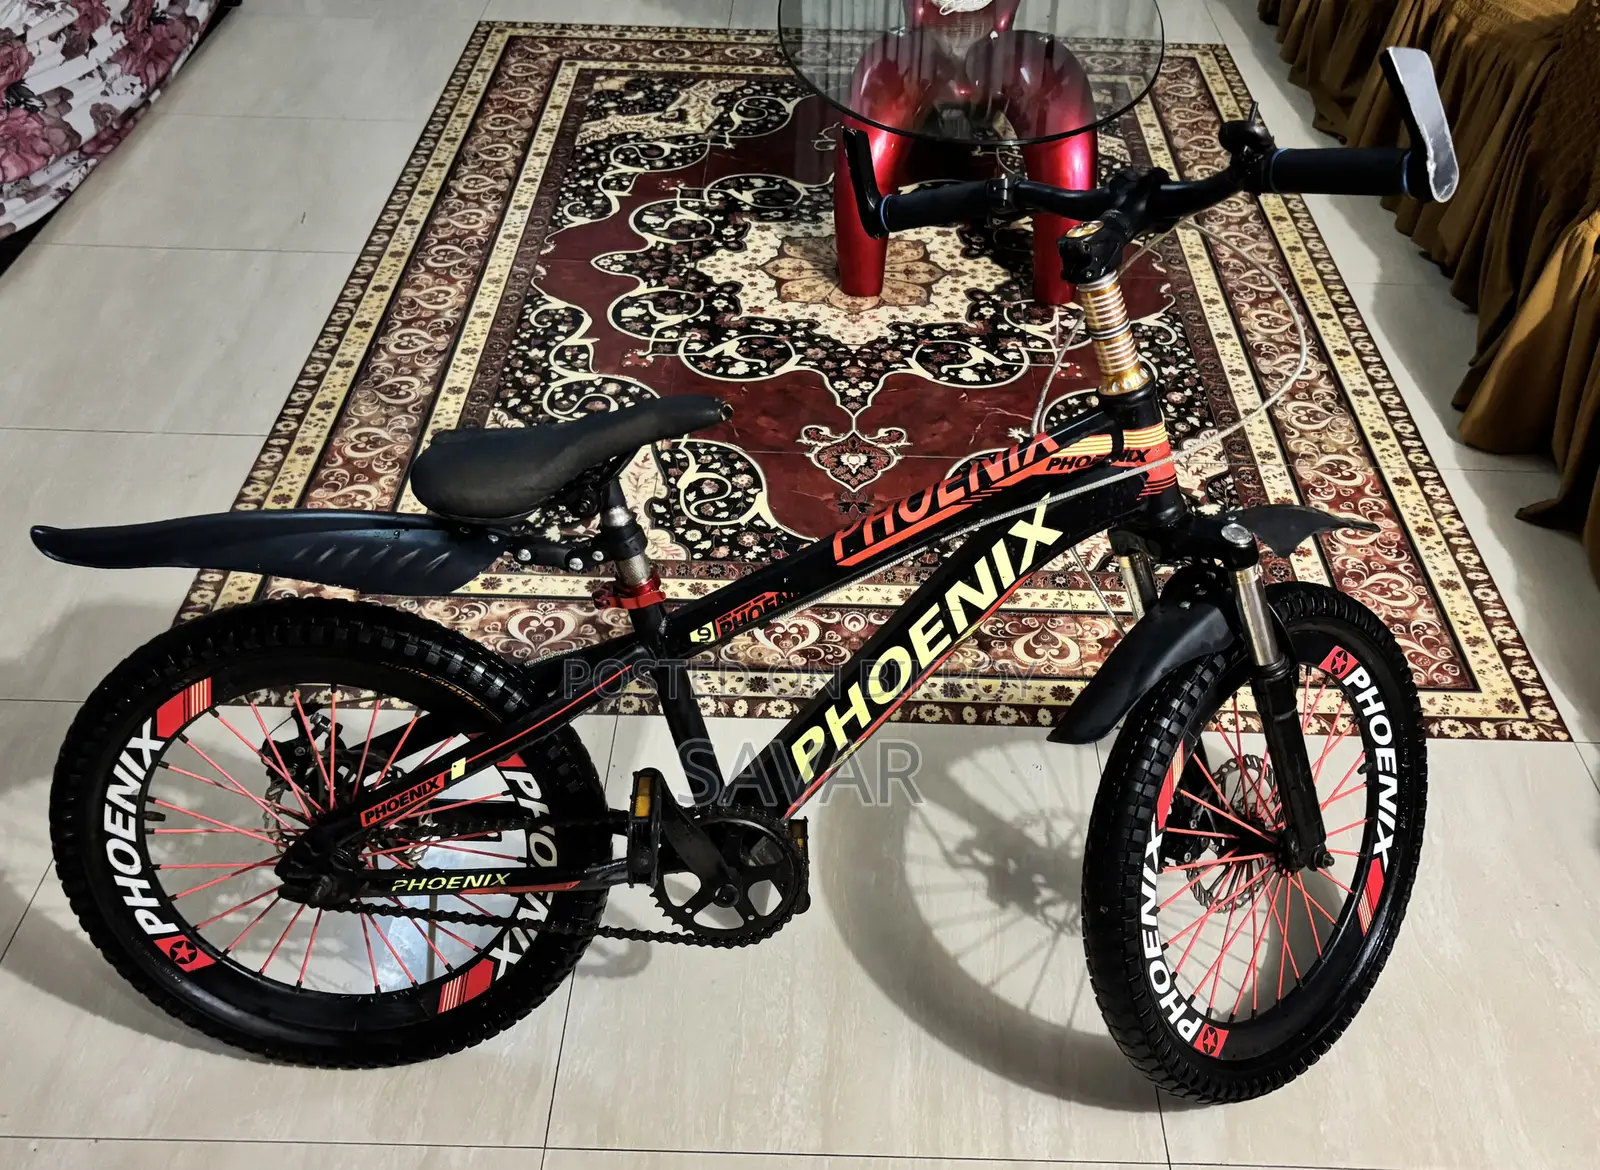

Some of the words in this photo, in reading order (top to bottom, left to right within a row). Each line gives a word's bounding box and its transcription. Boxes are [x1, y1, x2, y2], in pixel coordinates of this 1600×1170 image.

[791, 491, 1063, 784] PHOENIX
[104, 717, 180, 935] PHOENIX
[364, 776, 441, 825] PHOENIX
[1342, 665, 1398, 873] PHOENIX
[391, 873, 511, 892] PHOENIX
[489, 770, 558, 981] PHONIX
[1141, 813, 1203, 1043] PHOENIX
